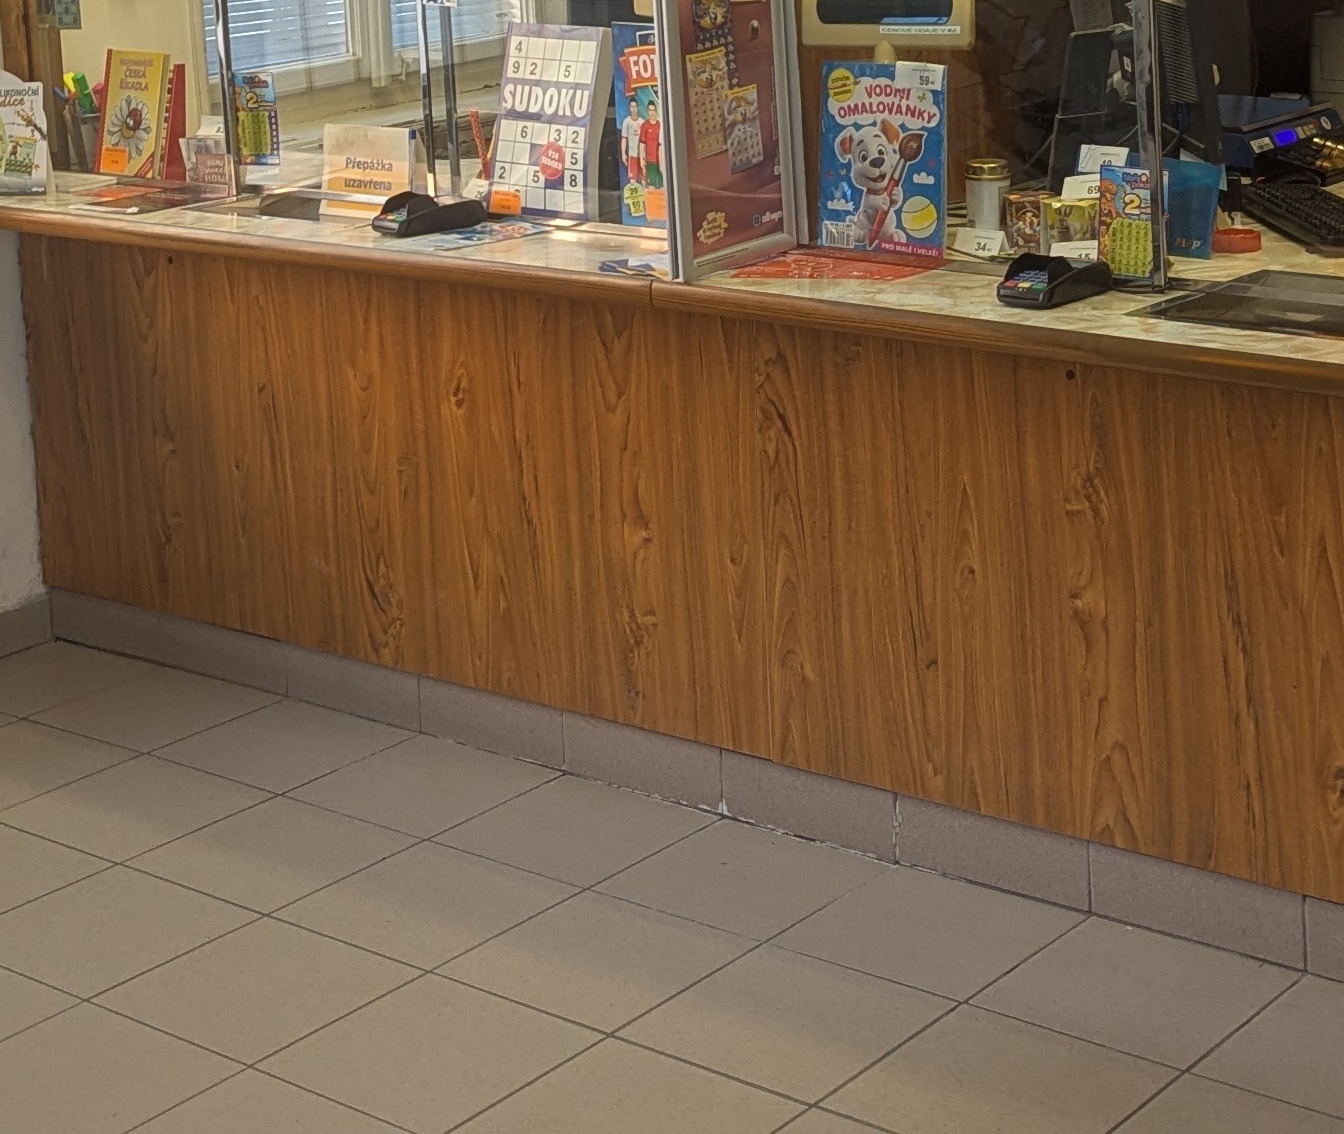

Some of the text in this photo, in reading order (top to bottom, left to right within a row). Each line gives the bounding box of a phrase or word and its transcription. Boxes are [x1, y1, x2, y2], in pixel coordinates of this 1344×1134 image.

[515, 40, 523, 54] 4
[512, 60, 571, 78] 9 2 5
[919, 75, 930, 86] 59
[246, 91, 258, 109] 2
[503, 83, 589, 117] SUDOKU
[838, 99, 937, 124] OMALOVÁNKY
[520, 125, 579, 144] 6 3 2
[345, 156, 393, 173] Přepážka
[570, 152, 578, 166] 5
[344, 177, 392, 191] uzavřena
[498, 166, 577, 188] 2 5 8
[1123, 194, 1141, 214] 2
[975, 241, 987, 252] 34
